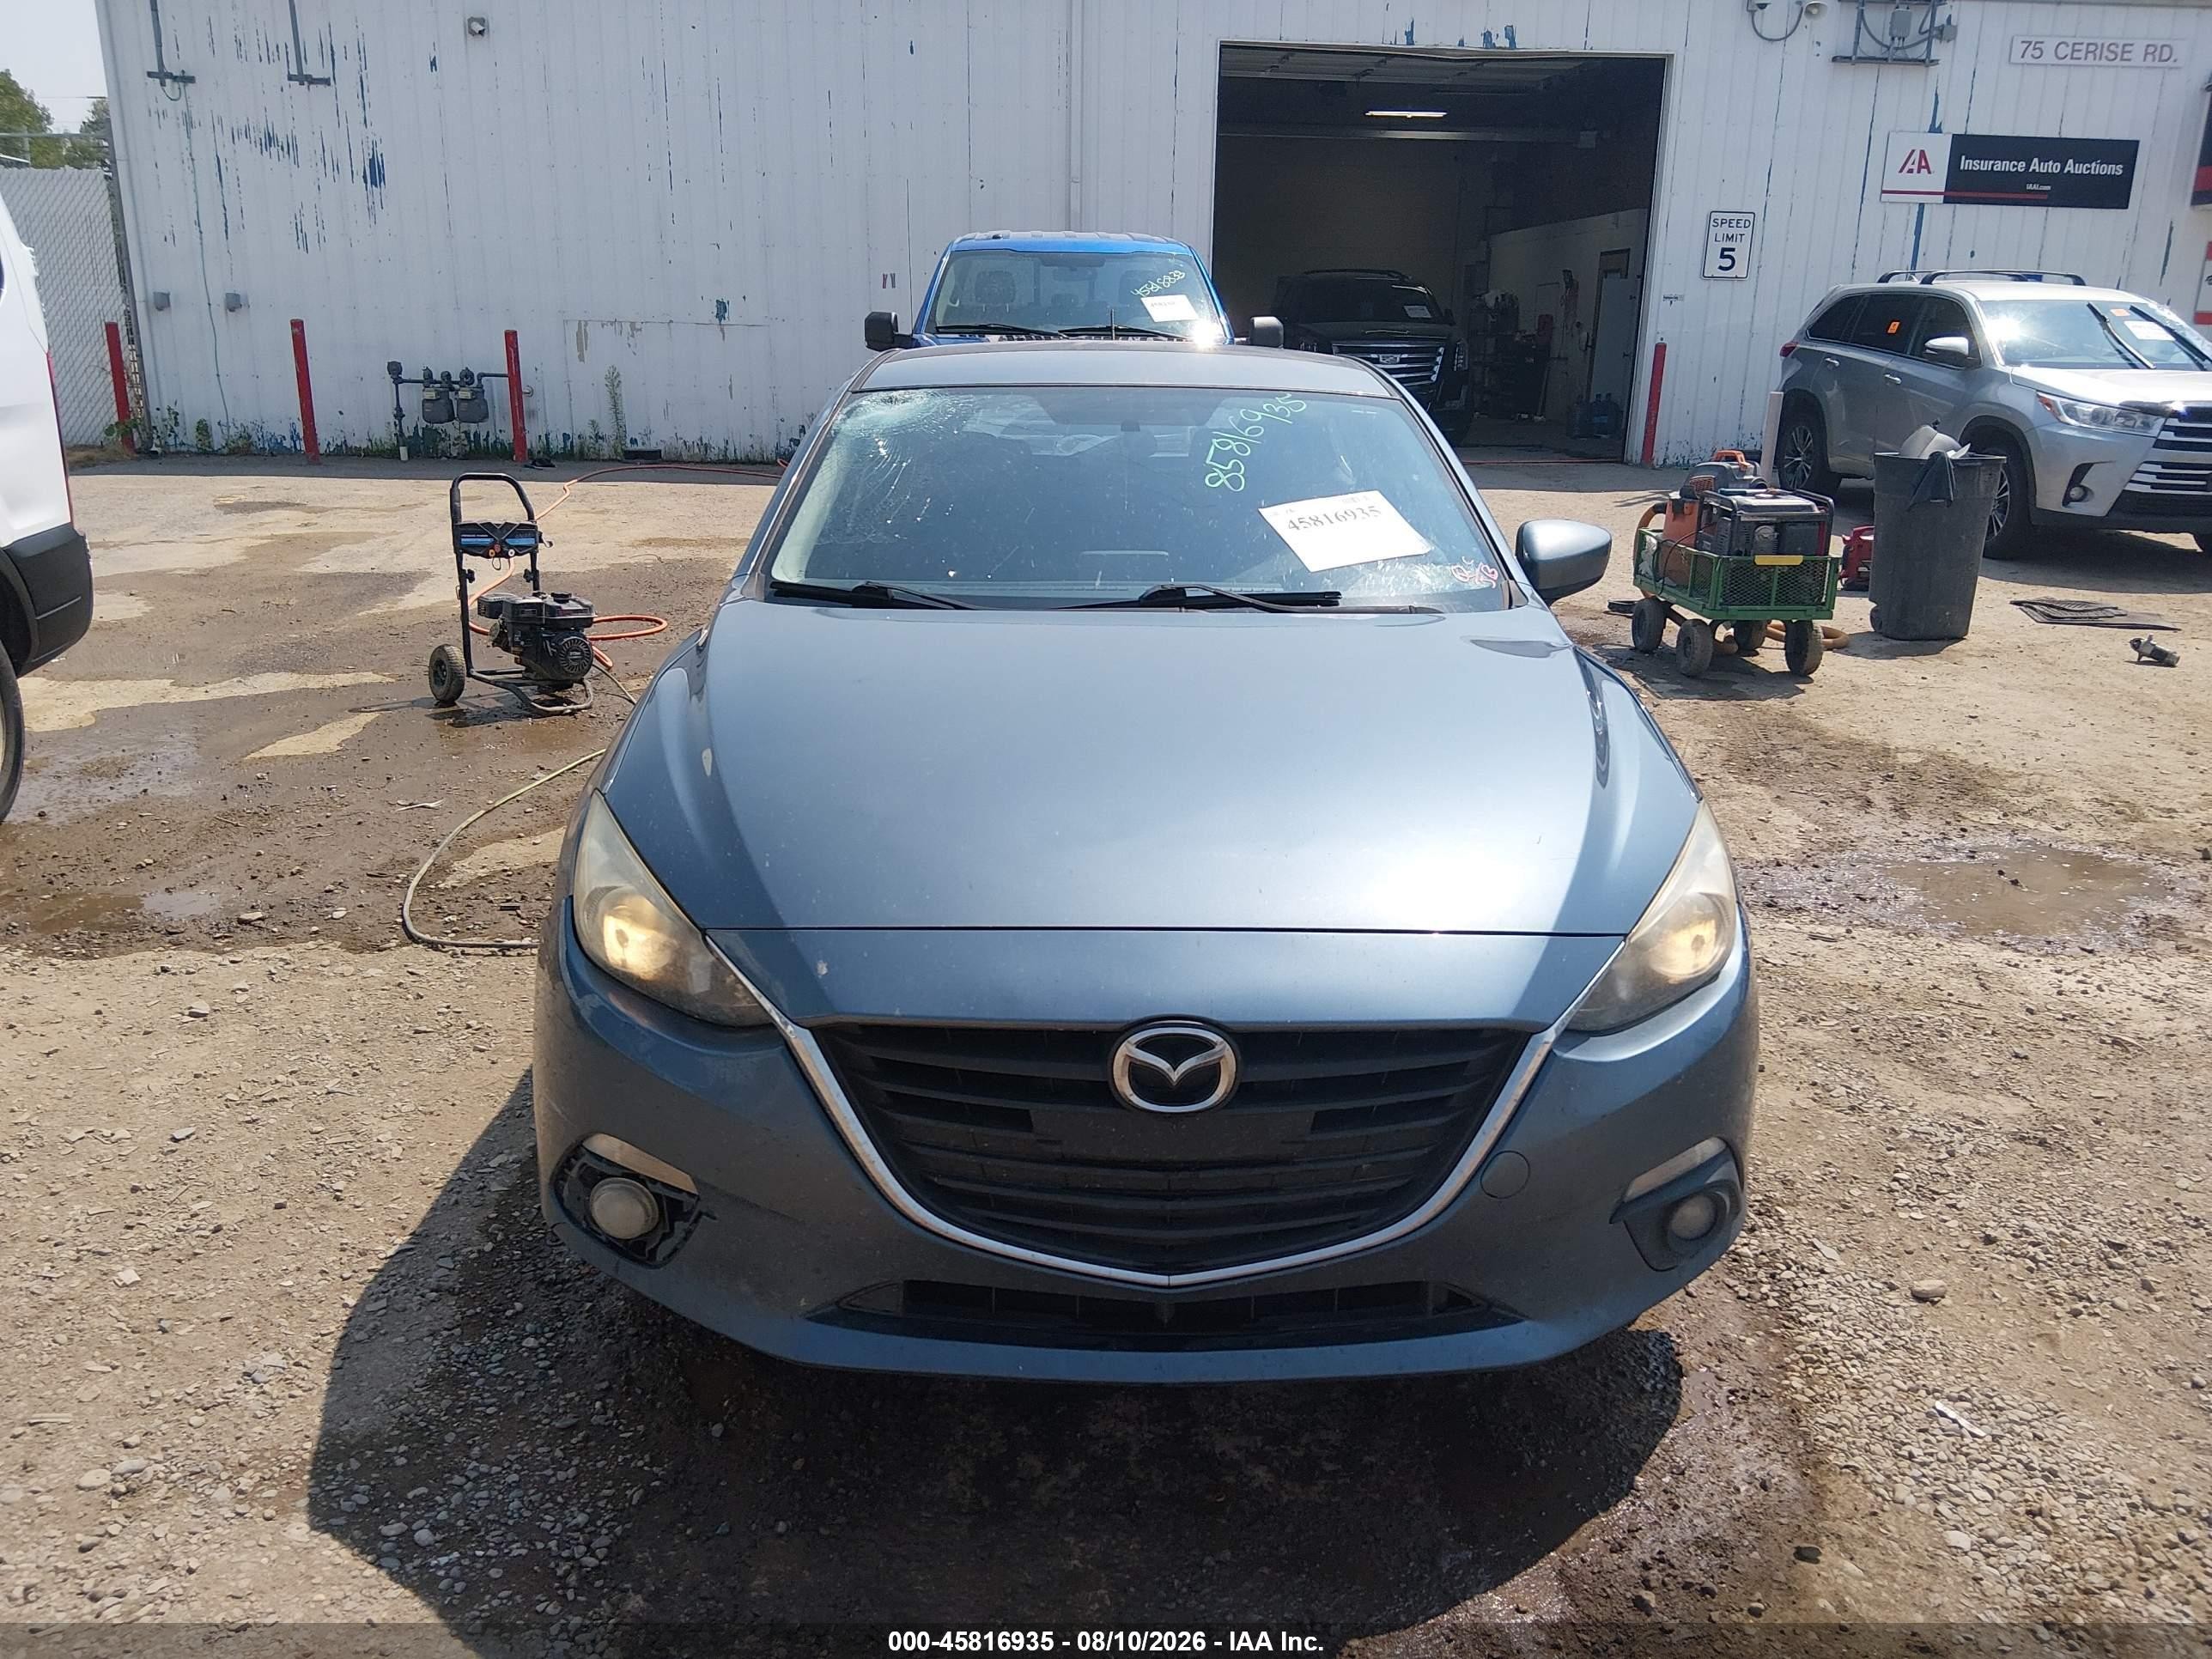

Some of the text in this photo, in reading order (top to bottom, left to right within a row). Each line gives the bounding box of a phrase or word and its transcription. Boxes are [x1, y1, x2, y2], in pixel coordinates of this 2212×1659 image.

[2021, 40, 2179, 63] 75 CERISE RD.
[1960, 155, 2124, 176] Insurance Auto Auctions
[1711, 218, 1751, 228] SPEED
[1714, 233, 1746, 242] LIMIT
[1717, 246, 1736, 271] 5
[1205, 392, 1307, 492] 85816935
[1288, 505, 1382, 532] 45816935
